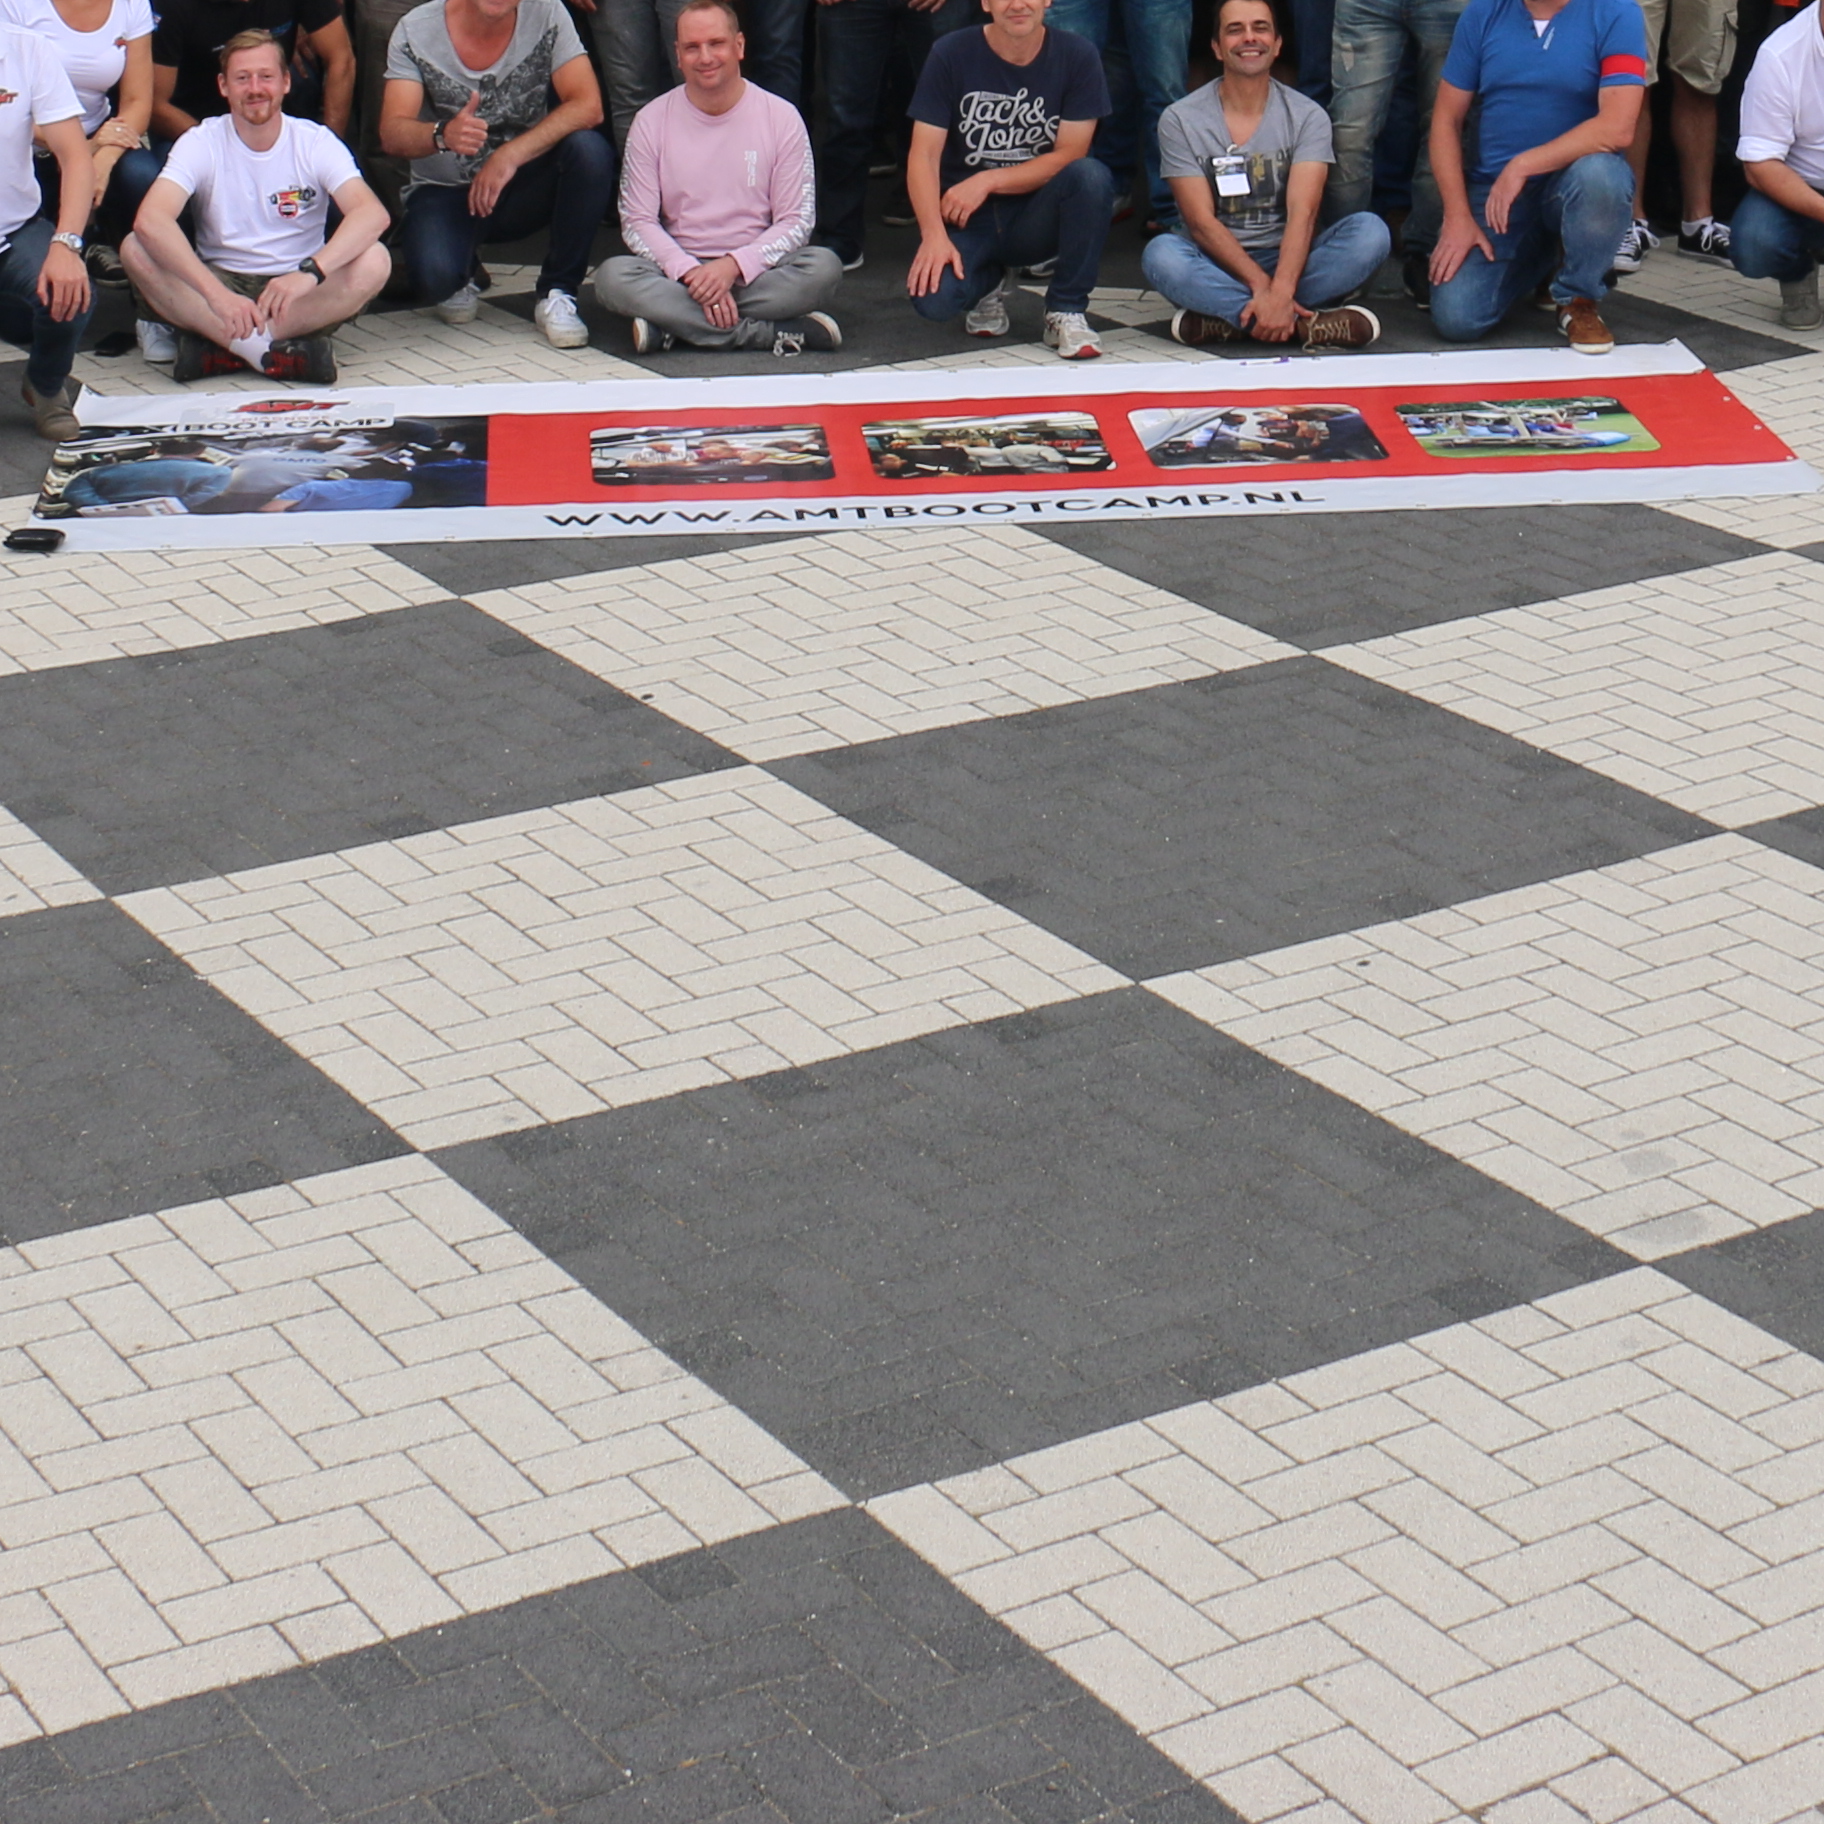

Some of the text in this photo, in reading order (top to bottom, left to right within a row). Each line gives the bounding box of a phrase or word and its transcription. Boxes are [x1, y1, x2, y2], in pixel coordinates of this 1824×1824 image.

[182, 417, 387, 432] BOOT CAMP
[543, 489, 1326, 527] WWW.AMTBOOTCAMP.NL
